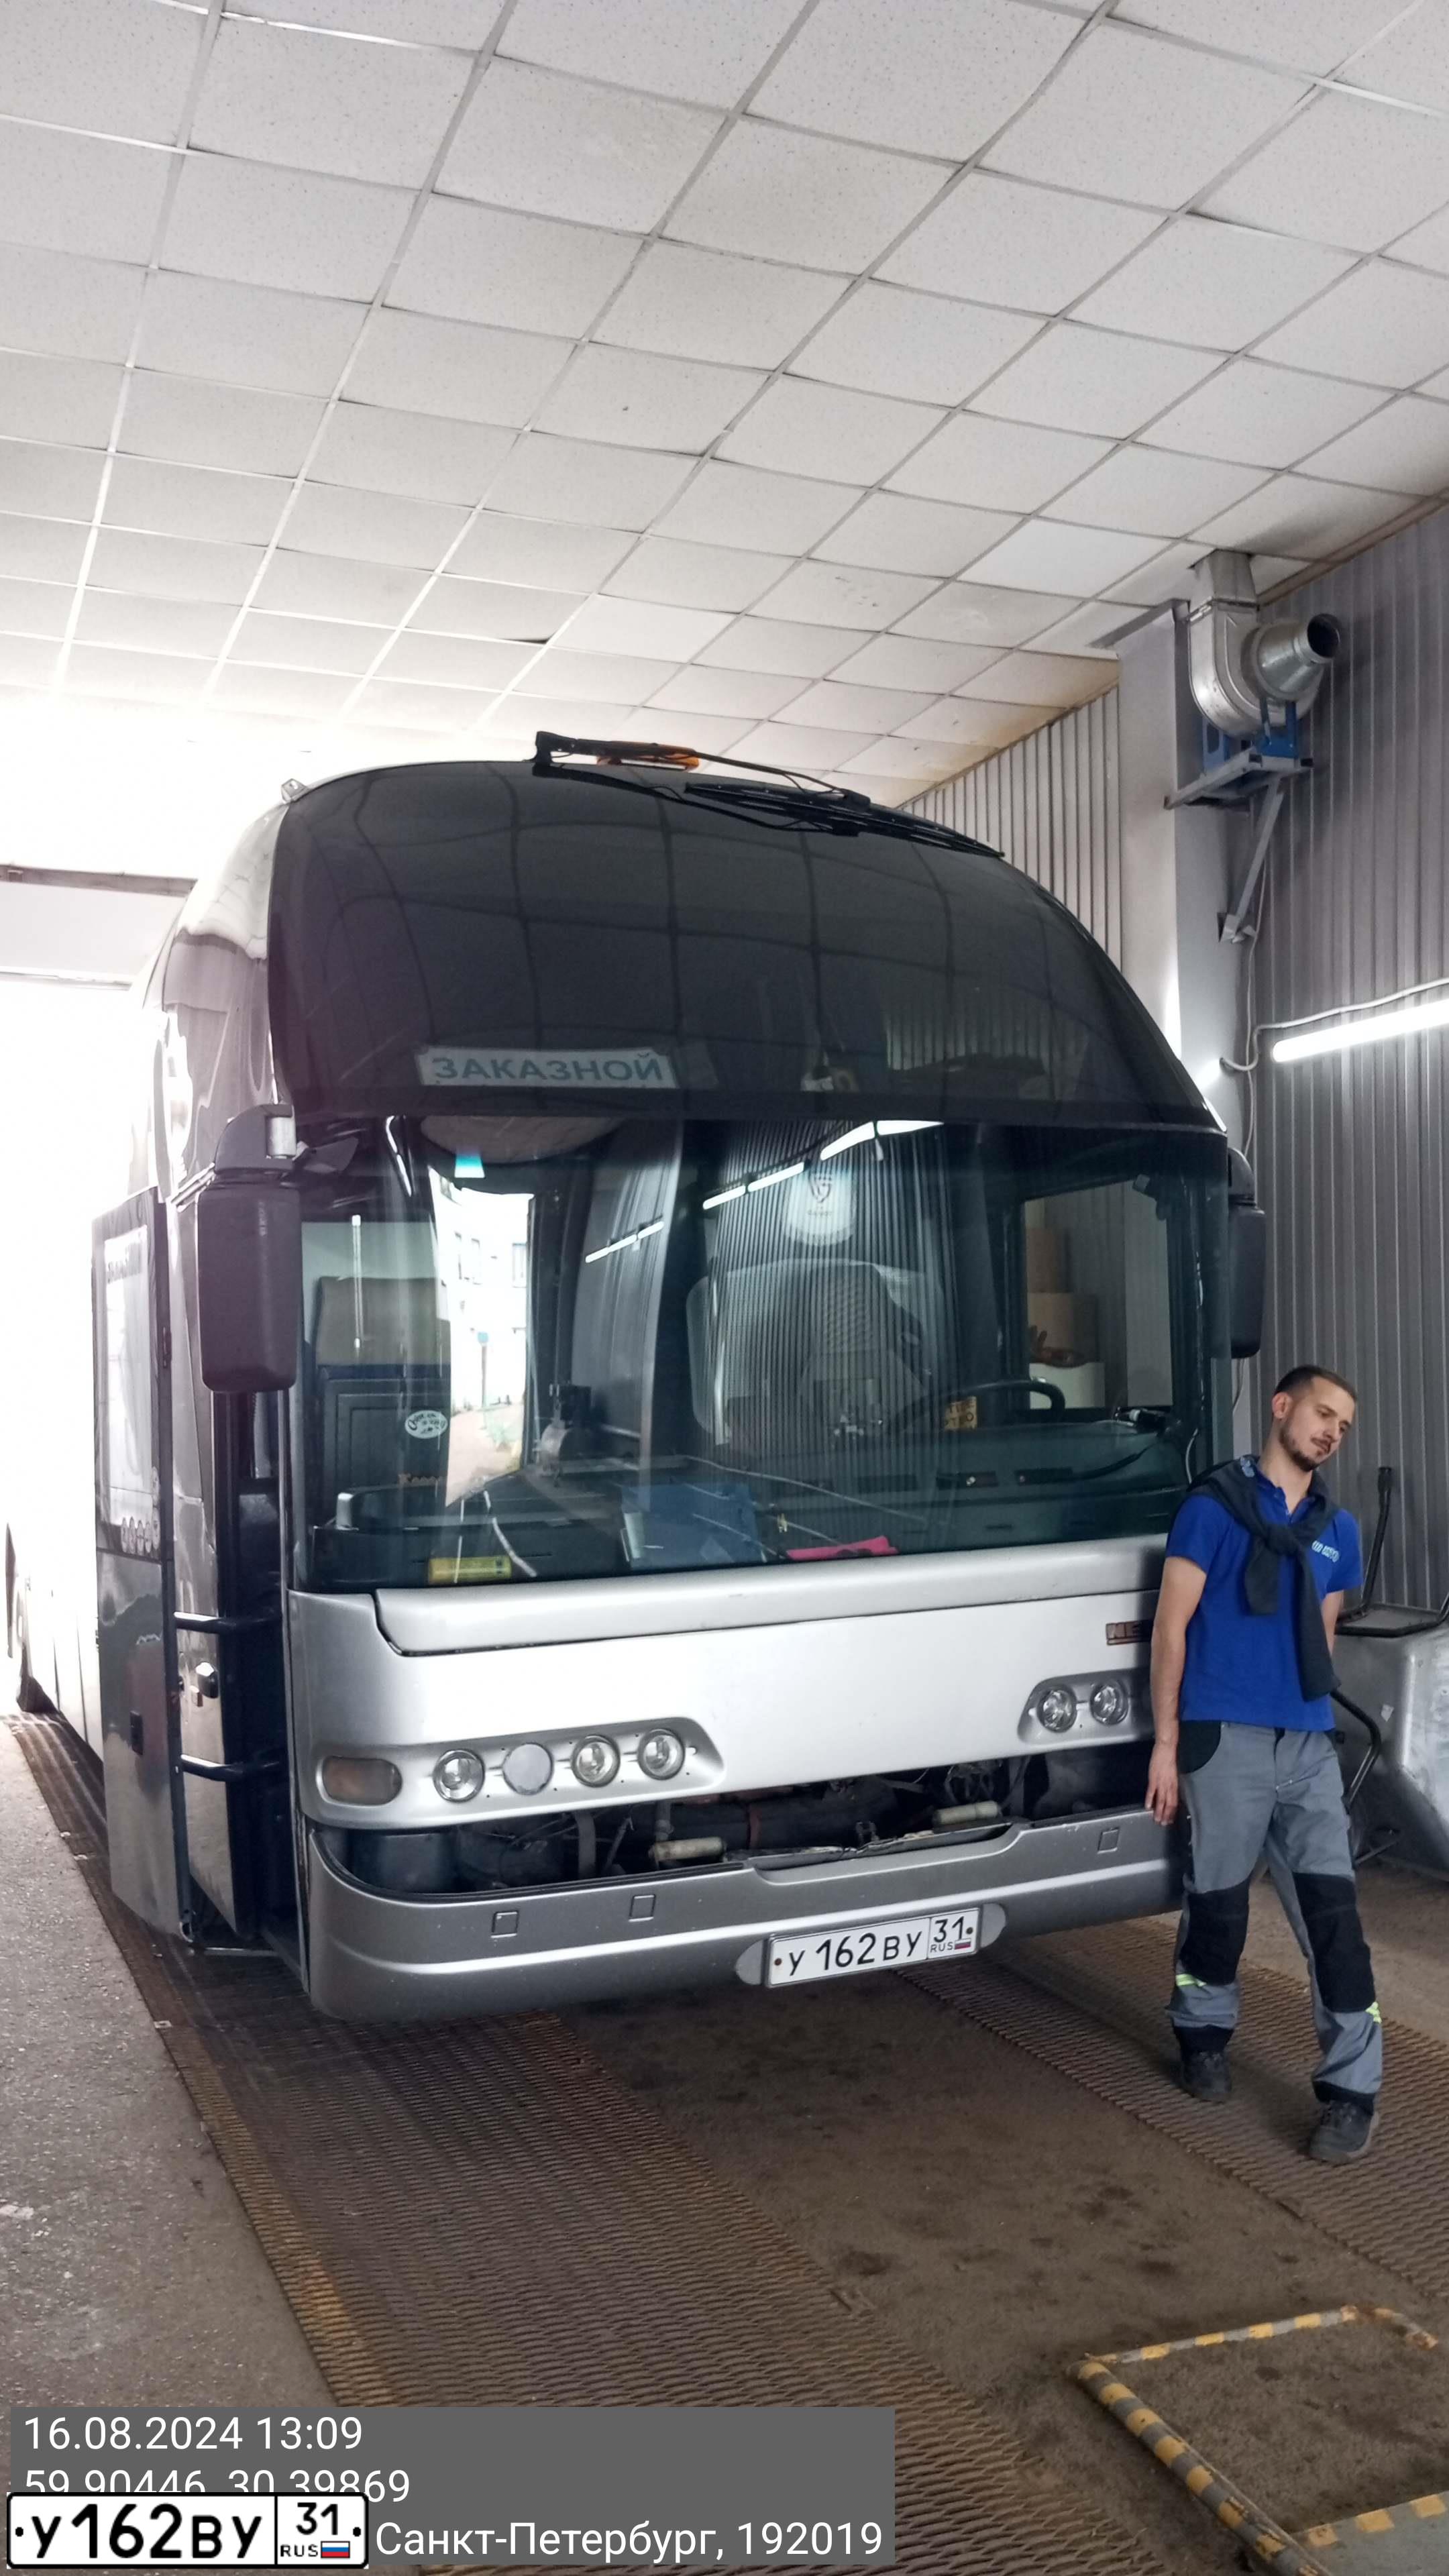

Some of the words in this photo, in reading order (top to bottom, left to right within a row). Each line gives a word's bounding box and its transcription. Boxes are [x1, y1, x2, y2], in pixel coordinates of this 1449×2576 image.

[431, 1051, 664, 1083] ЗАКАЗНОЙ
[933, 1916, 965, 1943] 31
[930, 1941, 954, 1953] RUS
